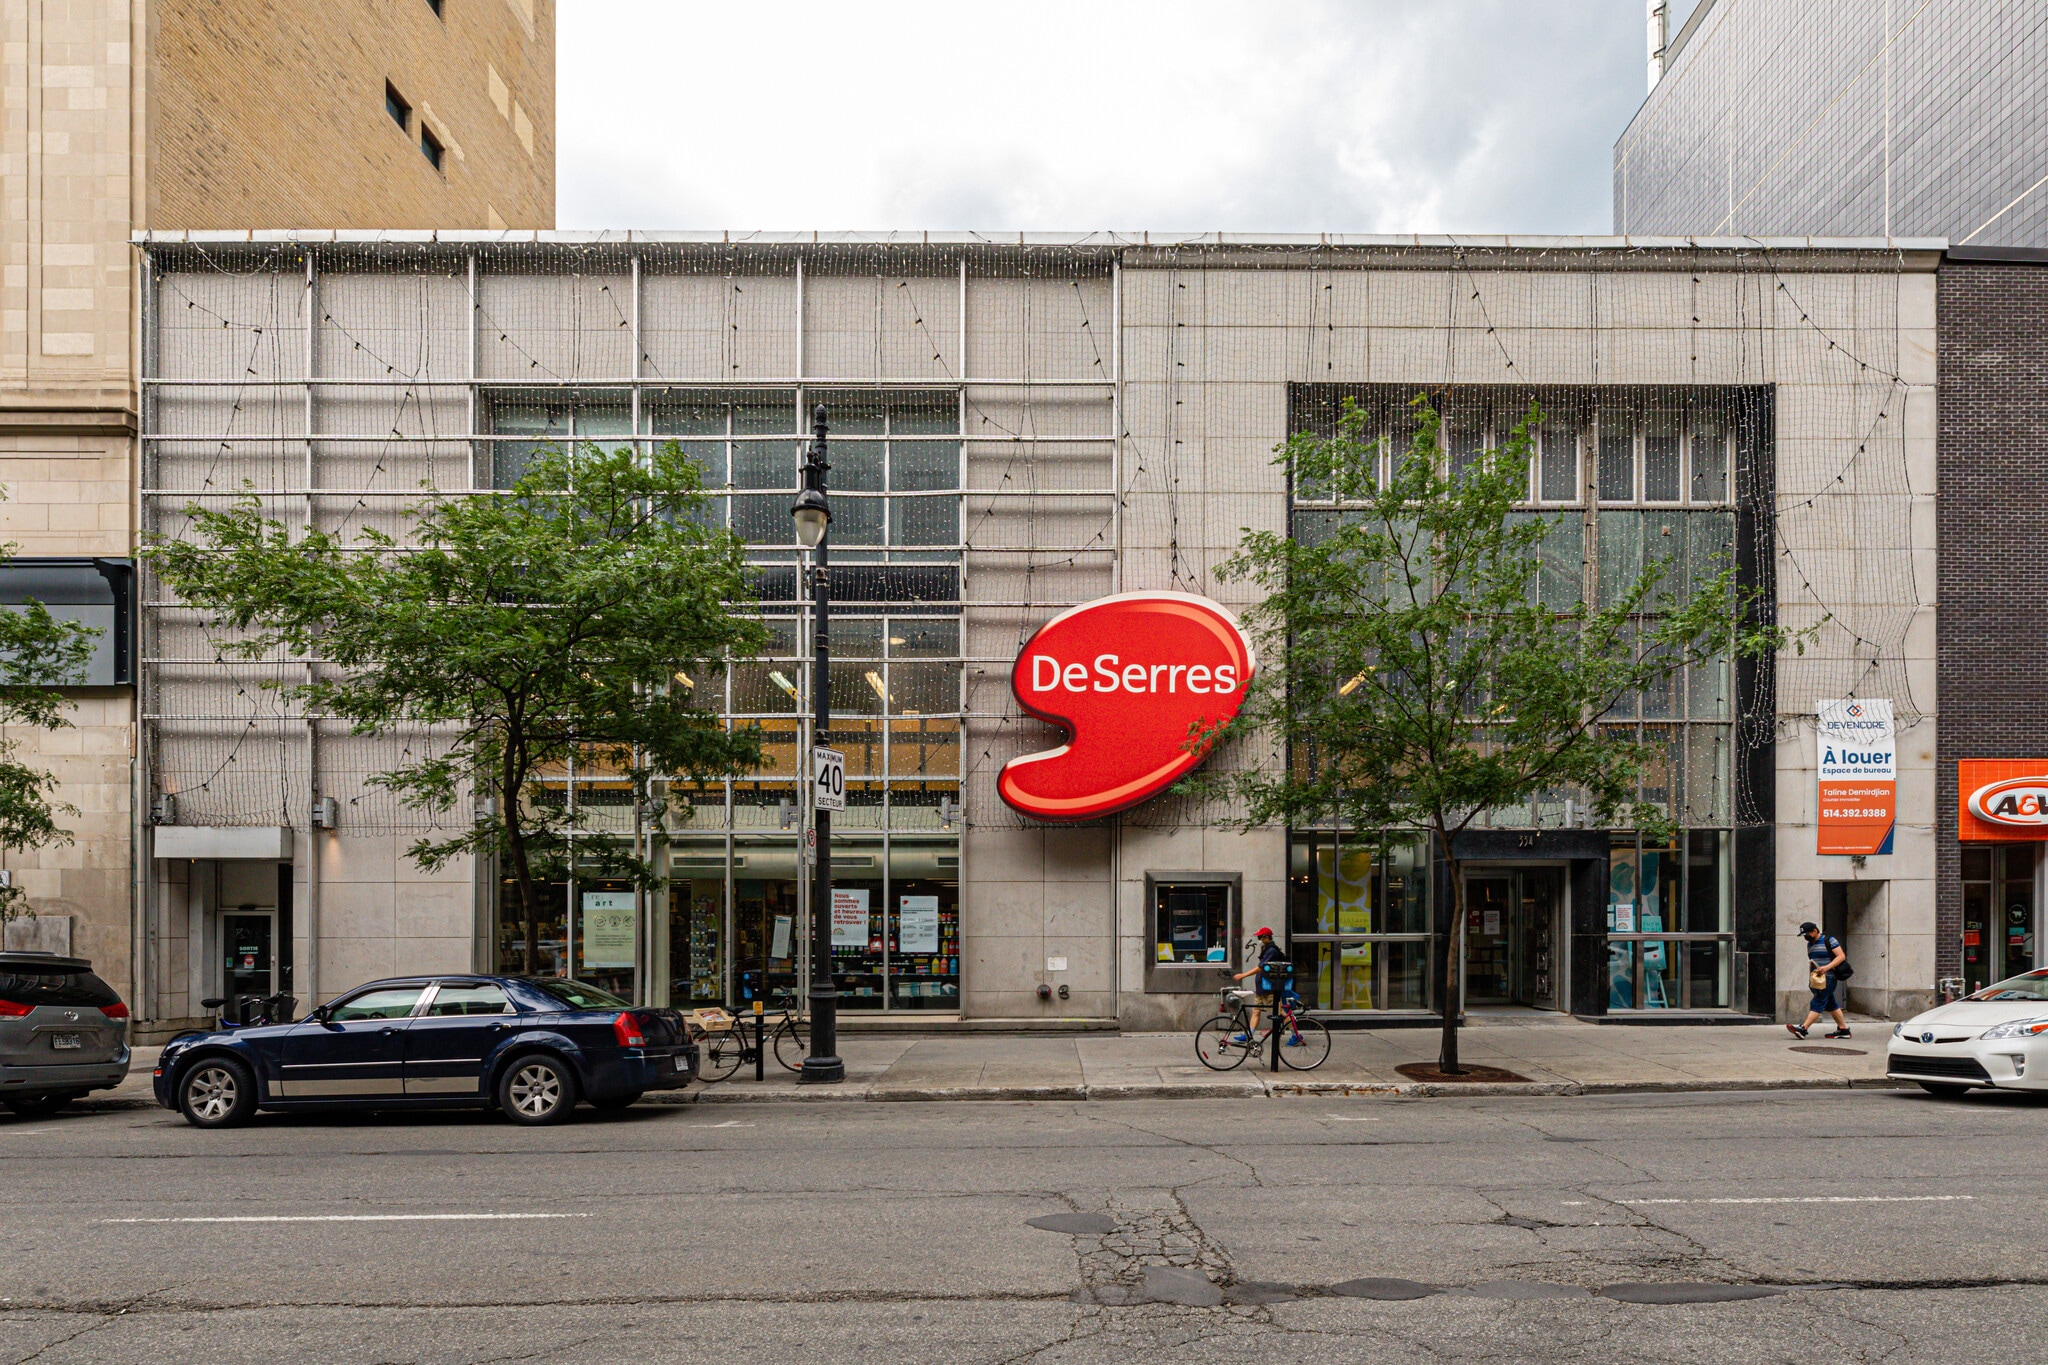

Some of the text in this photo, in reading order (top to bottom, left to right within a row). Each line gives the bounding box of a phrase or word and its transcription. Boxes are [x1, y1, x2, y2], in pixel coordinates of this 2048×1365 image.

[1032, 654, 1236, 693] DeSerres
[1827, 721, 1885, 729] DEVENCORE
[817, 751, 842, 763] MAXIMUM
[1823, 745, 1892, 764] À louer
[1822, 767, 1851, 775] Espace
[818, 763, 842, 796] 40
[1848, 788, 1890, 797] Demirdjian
[818, 796, 842, 807] SECTEUR
[1823, 808, 1886, 818] 514.392.9388
[1519, 835, 1533, 847] 334
